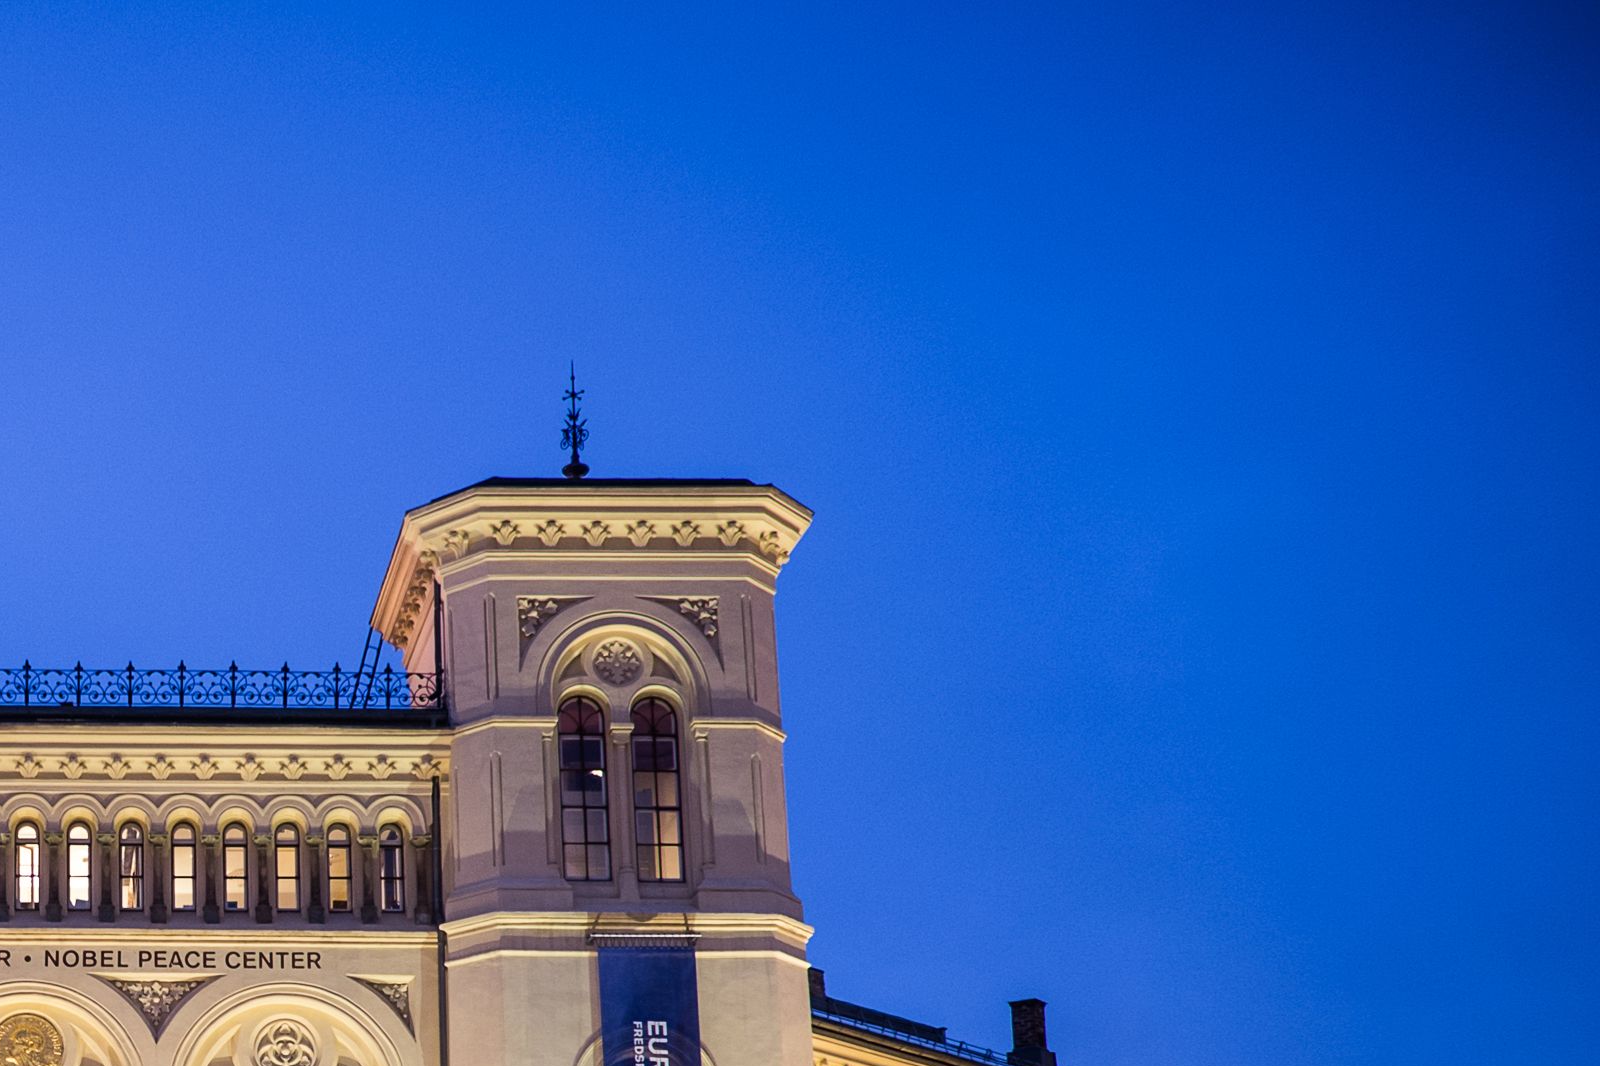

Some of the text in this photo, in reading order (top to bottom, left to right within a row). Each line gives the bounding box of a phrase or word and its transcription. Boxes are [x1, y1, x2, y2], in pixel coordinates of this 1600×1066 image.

[45, 949, 128, 969] NOBEL
[138, 950, 216, 970] PEACE
[226, 950, 322, 970] CENTER
